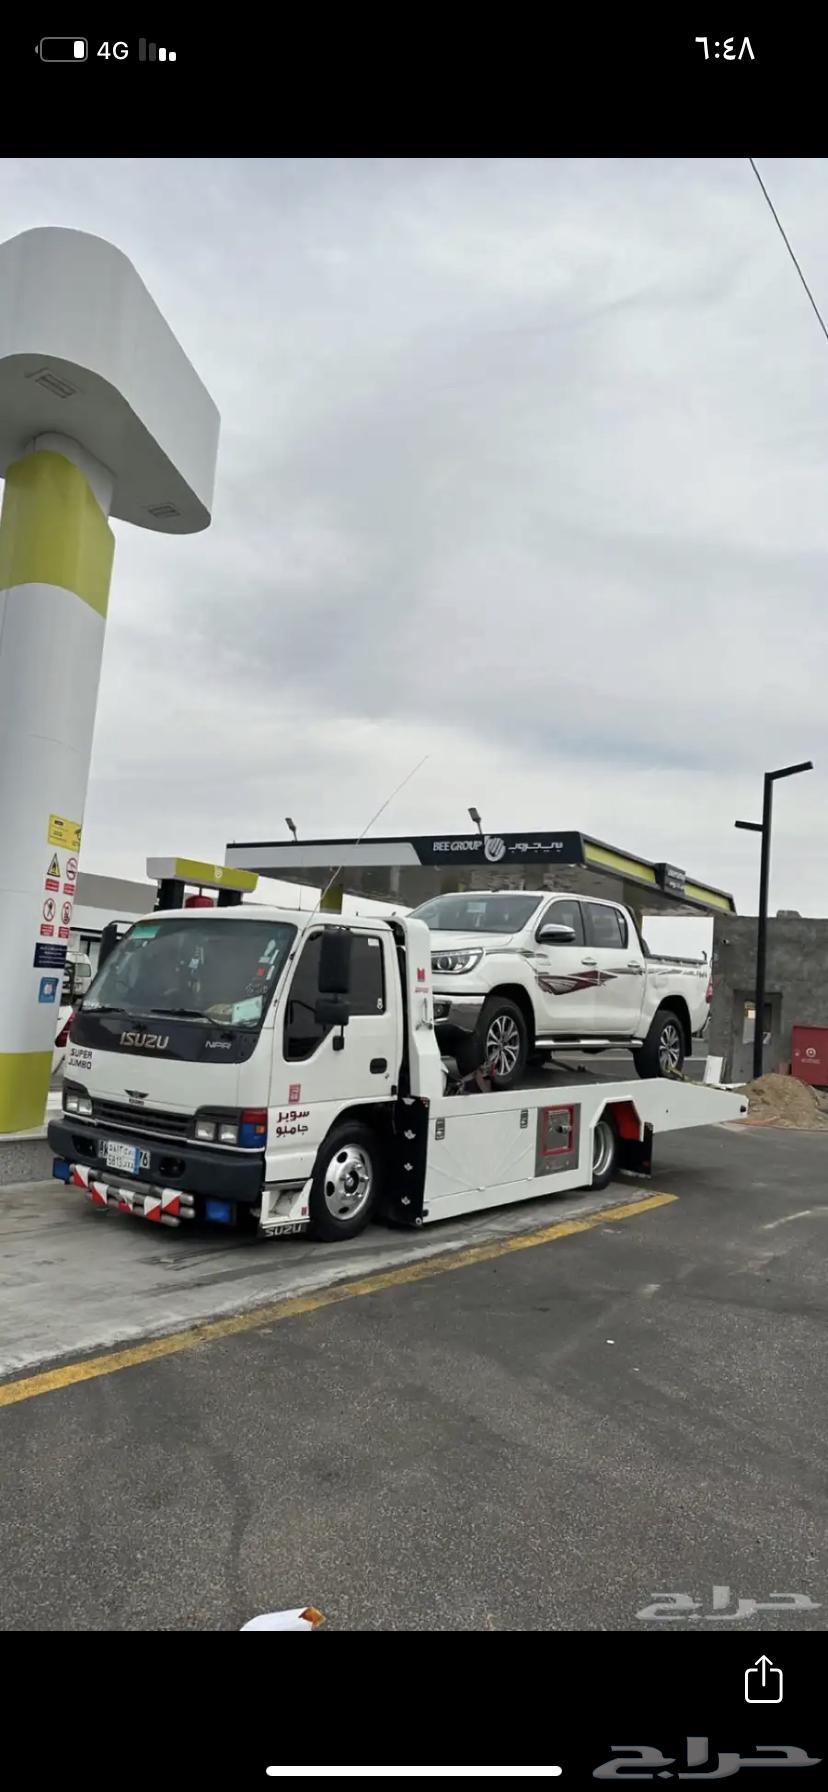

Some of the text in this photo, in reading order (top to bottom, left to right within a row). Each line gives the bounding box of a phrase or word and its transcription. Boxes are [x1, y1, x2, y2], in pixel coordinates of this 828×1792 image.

[433, 840, 483, 852] BEE GROUP
[119, 1031, 169, 1049] ISUZU
[205, 1040, 232, 1050] NPR
[70, 1048, 93, 1060] SUPER
[68, 1058, 92, 1070] JUMBO
[276, 1111, 310, 1123] سوبر
[275, 1123, 309, 1138] جامبو
